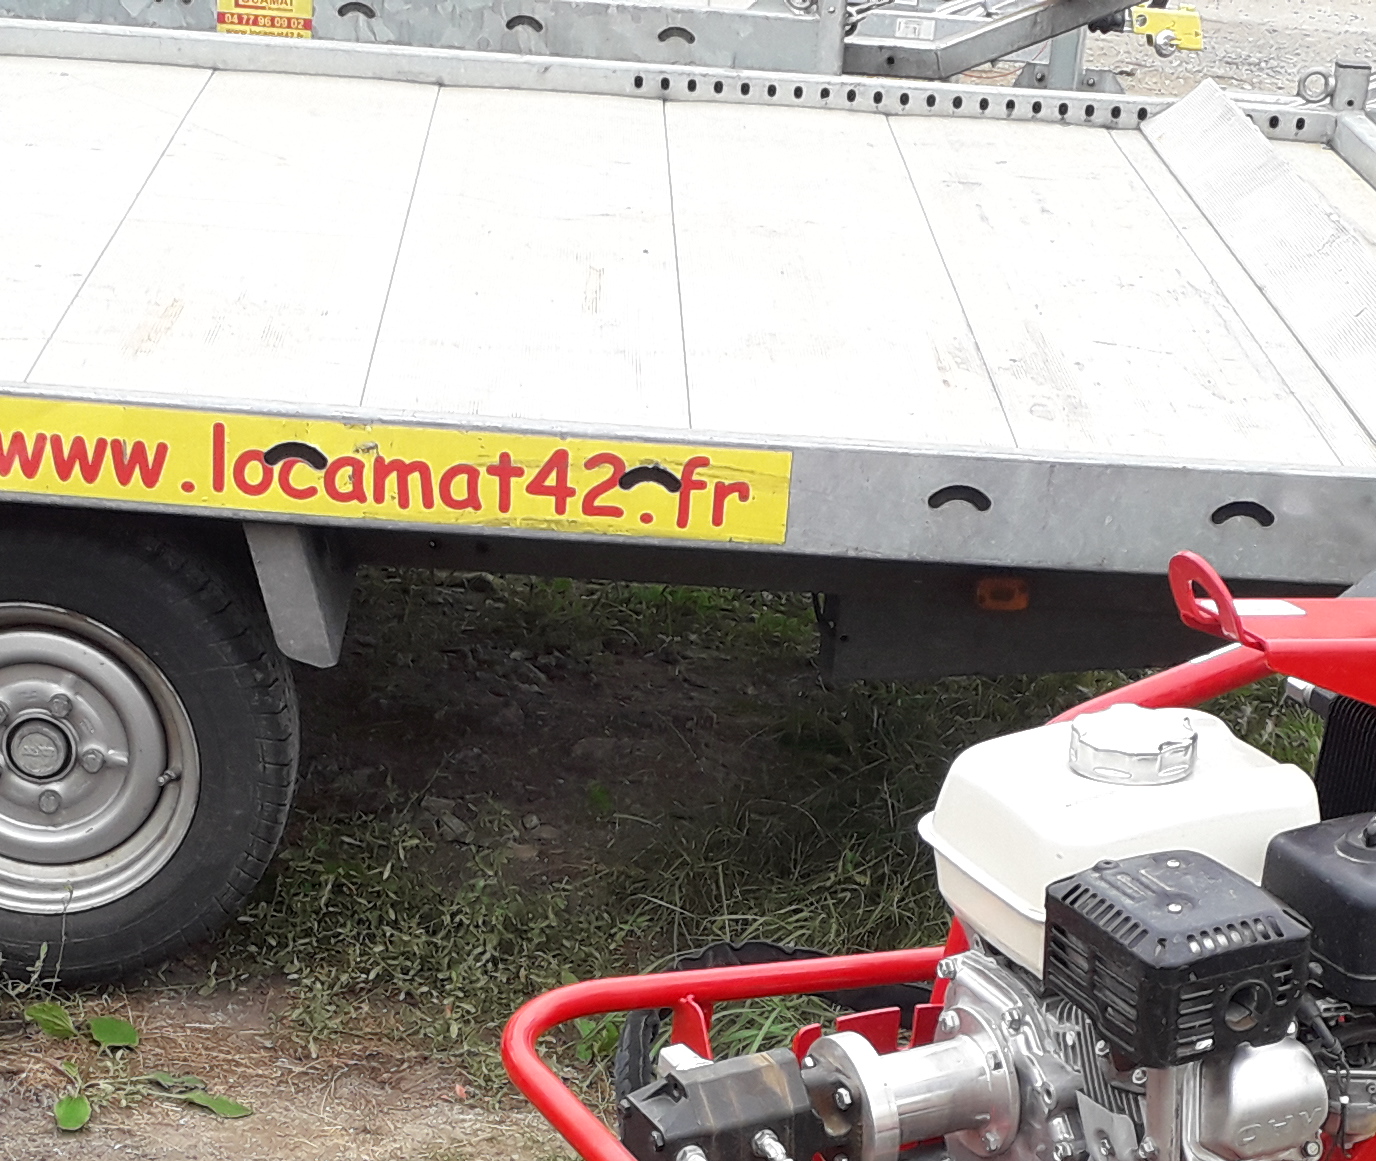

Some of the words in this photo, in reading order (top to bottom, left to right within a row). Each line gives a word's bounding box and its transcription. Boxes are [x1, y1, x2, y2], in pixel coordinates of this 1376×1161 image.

[224, 14, 239, 24] 04
[242, 15, 255, 26] 77
[257, 16, 272, 27] 96
[274, 17, 288, 27] 09
[290, 18, 305, 29] 02
